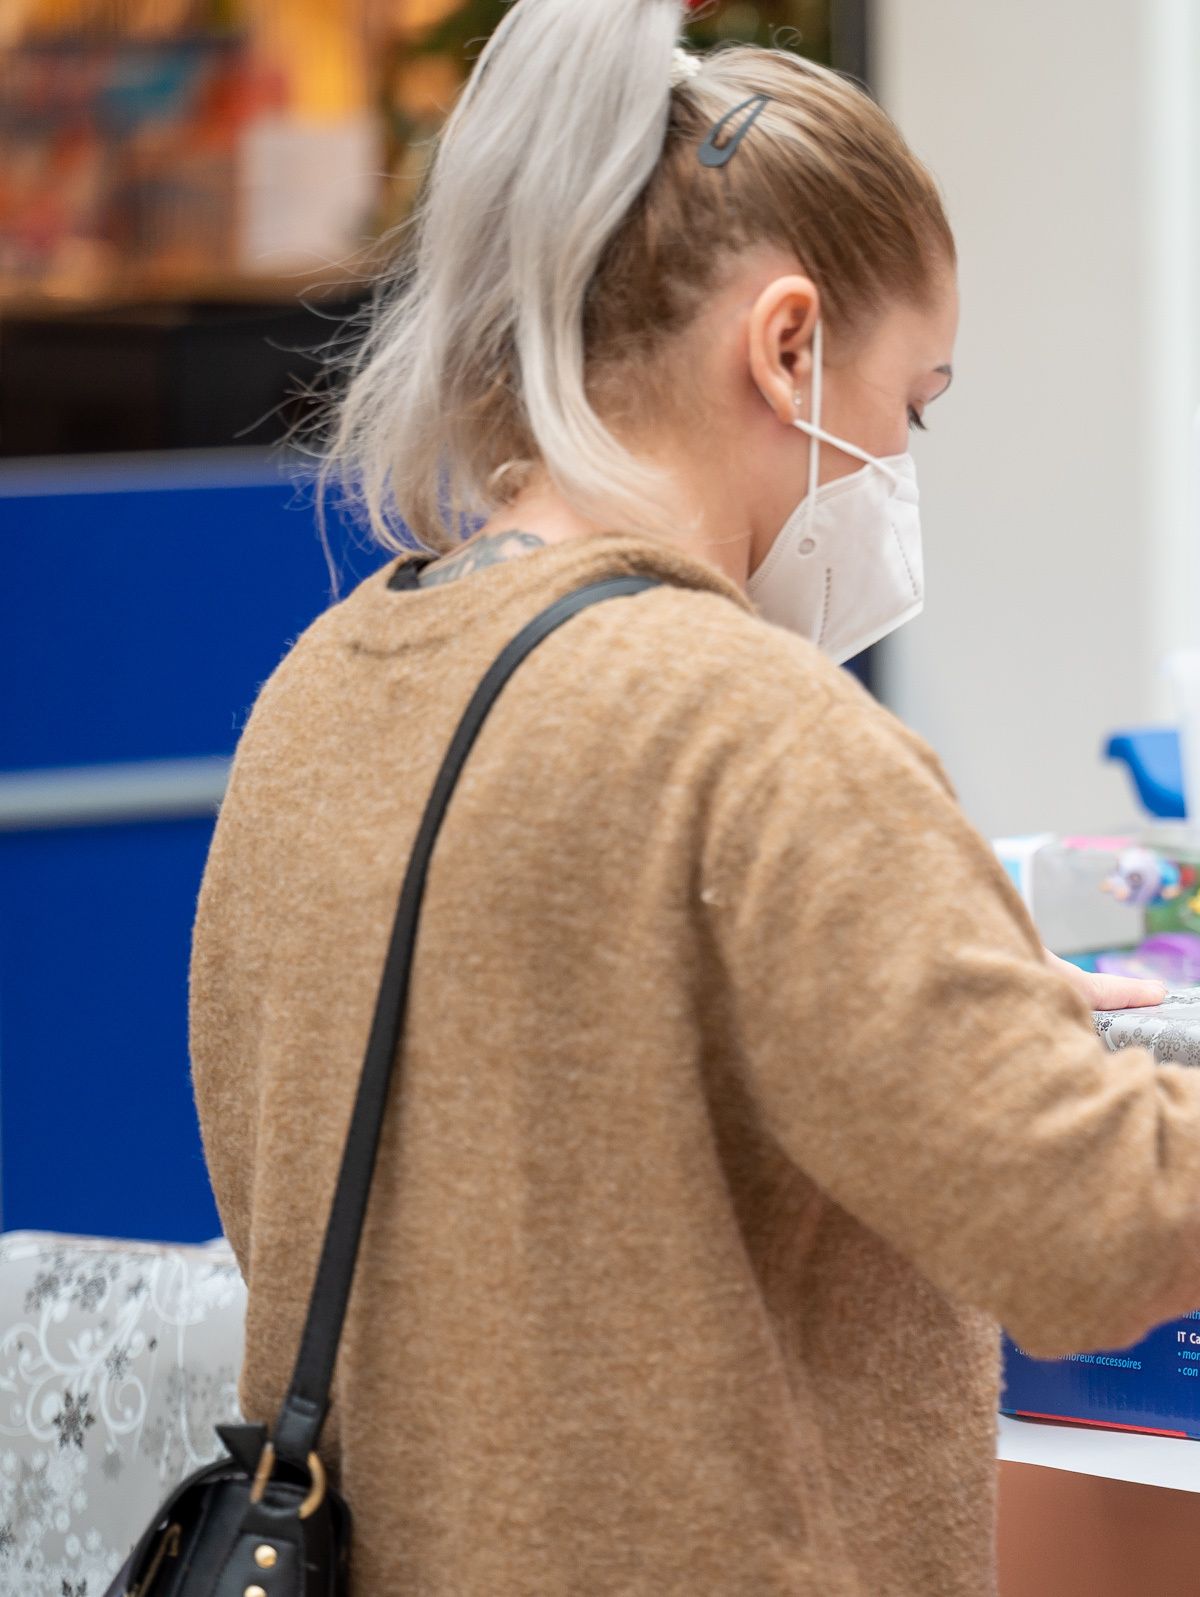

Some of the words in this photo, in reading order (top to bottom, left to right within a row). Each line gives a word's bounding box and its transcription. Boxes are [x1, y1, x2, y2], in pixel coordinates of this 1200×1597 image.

[1177, 1331, 1187, 1343] IT
[1054, 1352, 1095, 1365] ombreux
[1095, 1355, 1142, 1370] accessoires
[1183, 1366, 1199, 1377] con
